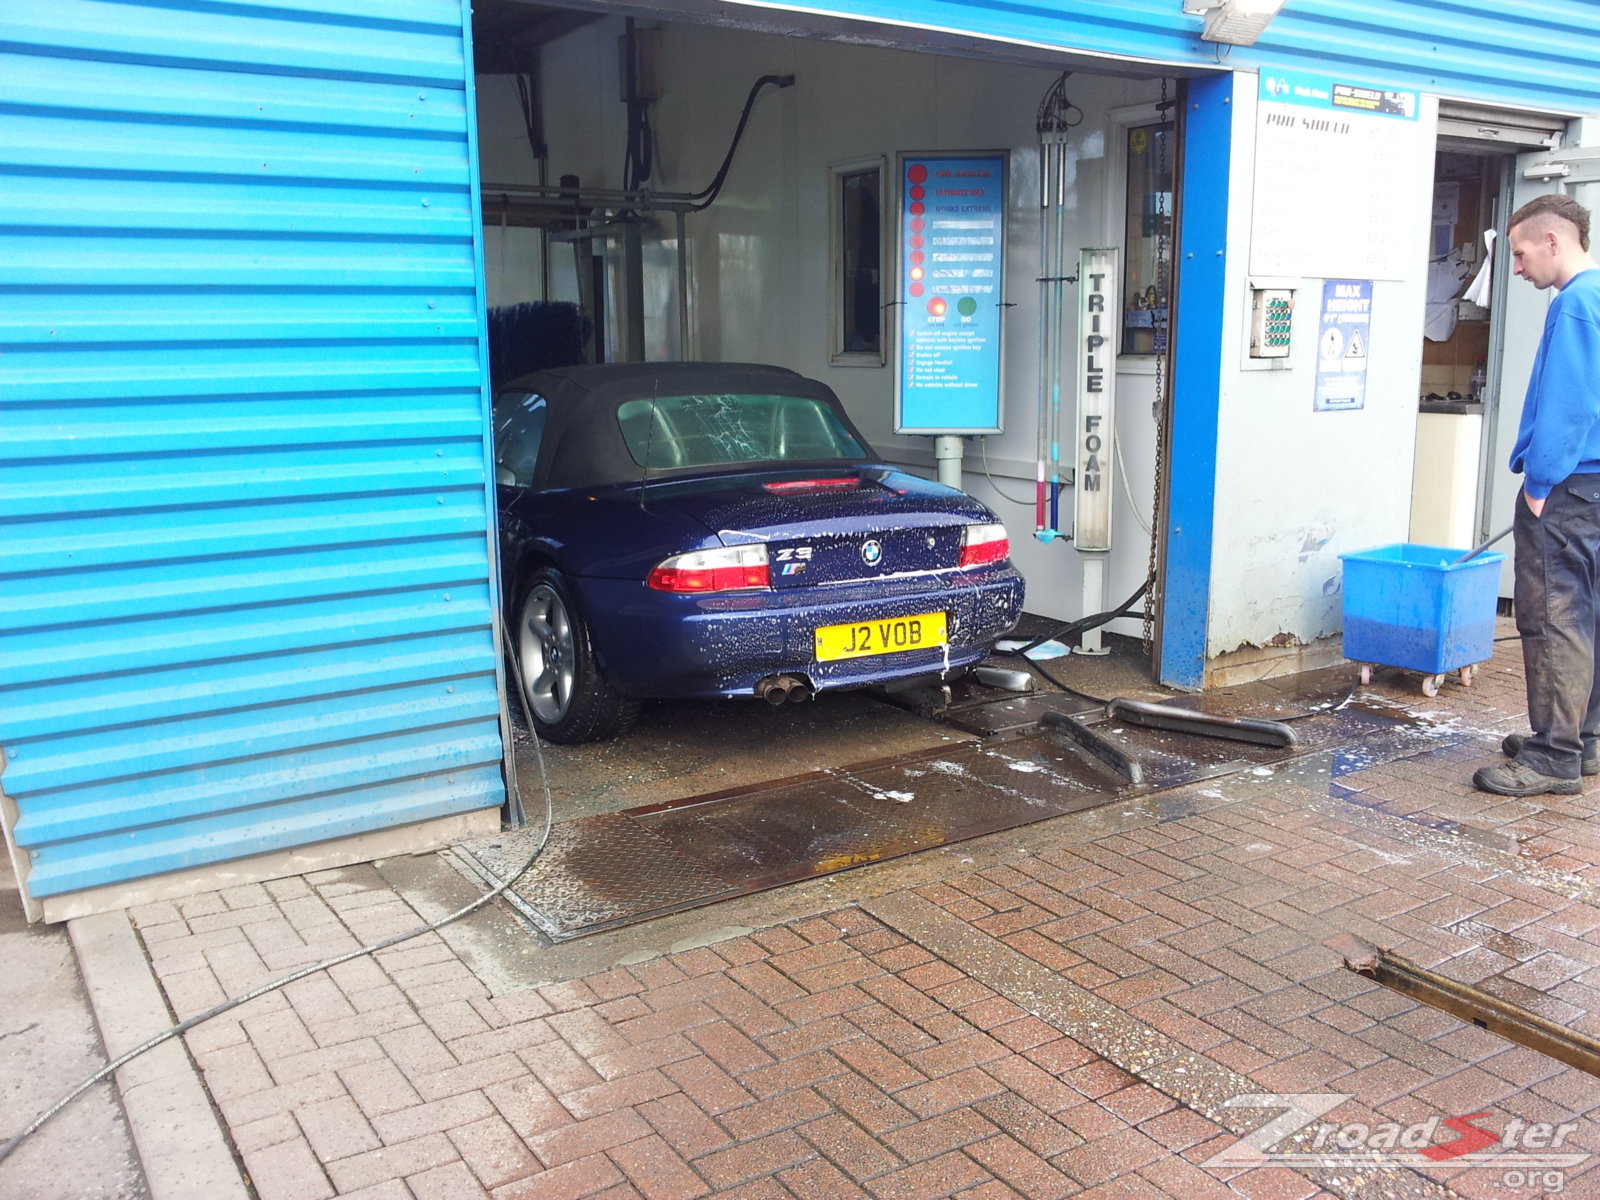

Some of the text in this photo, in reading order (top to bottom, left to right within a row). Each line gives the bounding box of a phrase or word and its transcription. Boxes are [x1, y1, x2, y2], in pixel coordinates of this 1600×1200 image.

[1335, 285, 1361, 298] MAX
[1327, 299, 1370, 312] HEIGHT
[1084, 273, 1105, 492] TRIPLE FOAM
[776, 547, 812, 561] Z3
[843, 620, 922, 652] J2 VOB
